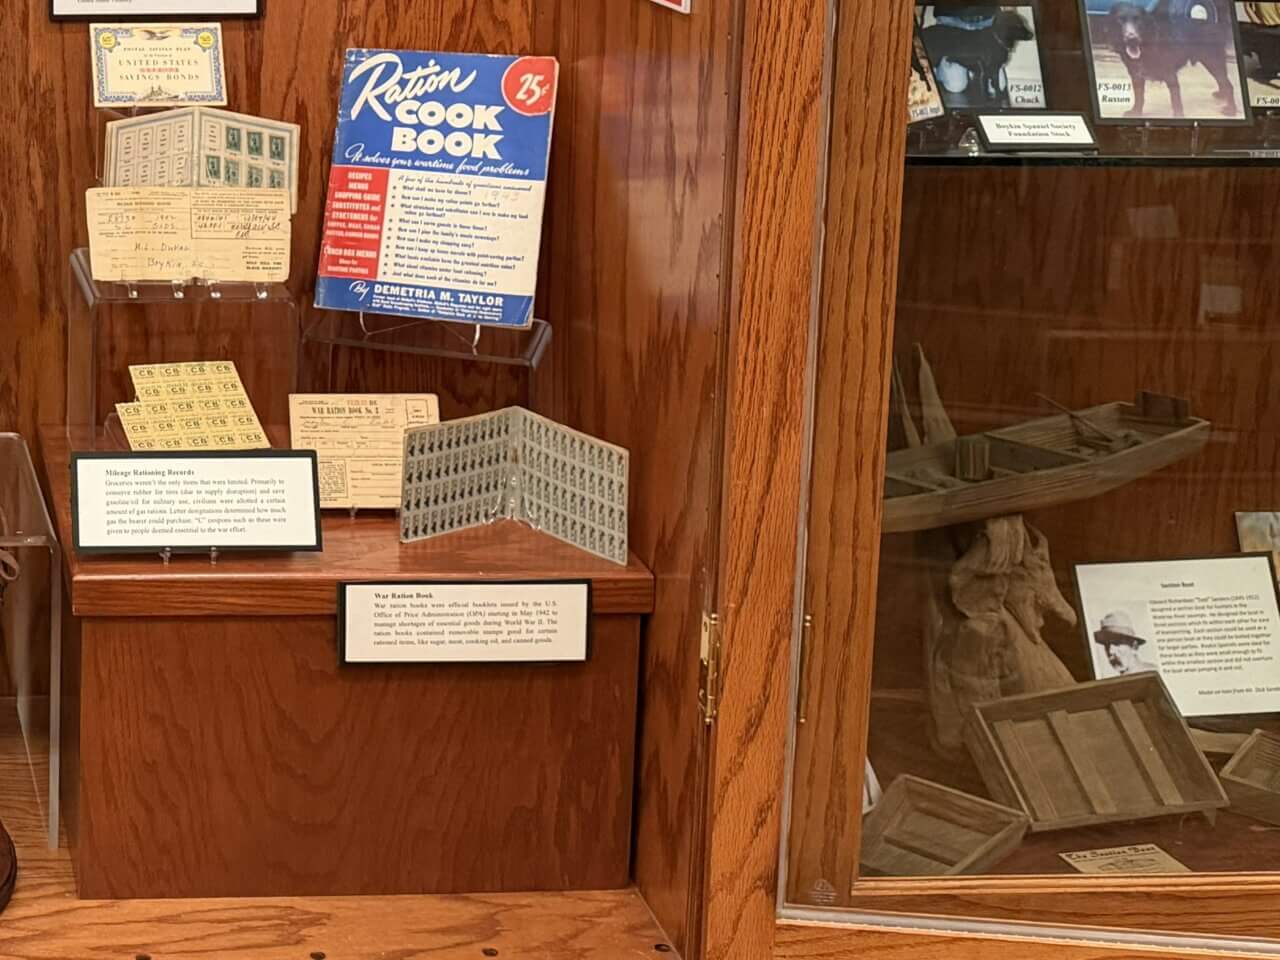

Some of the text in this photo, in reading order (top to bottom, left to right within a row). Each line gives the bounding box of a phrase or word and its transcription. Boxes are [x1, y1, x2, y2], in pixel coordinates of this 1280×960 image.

[348, 53, 477, 122] Ration
[395, 100, 506, 131] COOK
[1050, 123, 1076, 131] Society
[391, 127, 504, 160] BOOK
[361, 154, 391, 165] solves
[391, 157, 412, 169] your
[413, 159, 454, 171] wartime
[456, 161, 480, 176] food
[481, 161, 530, 176] problems
[349, 280, 504, 307] By DEMETRIA M. TAYLOR
[348, 406, 362, 415] BOOK
[106, 469, 131, 478] Mileage
[133, 469, 166, 477] Rationing
